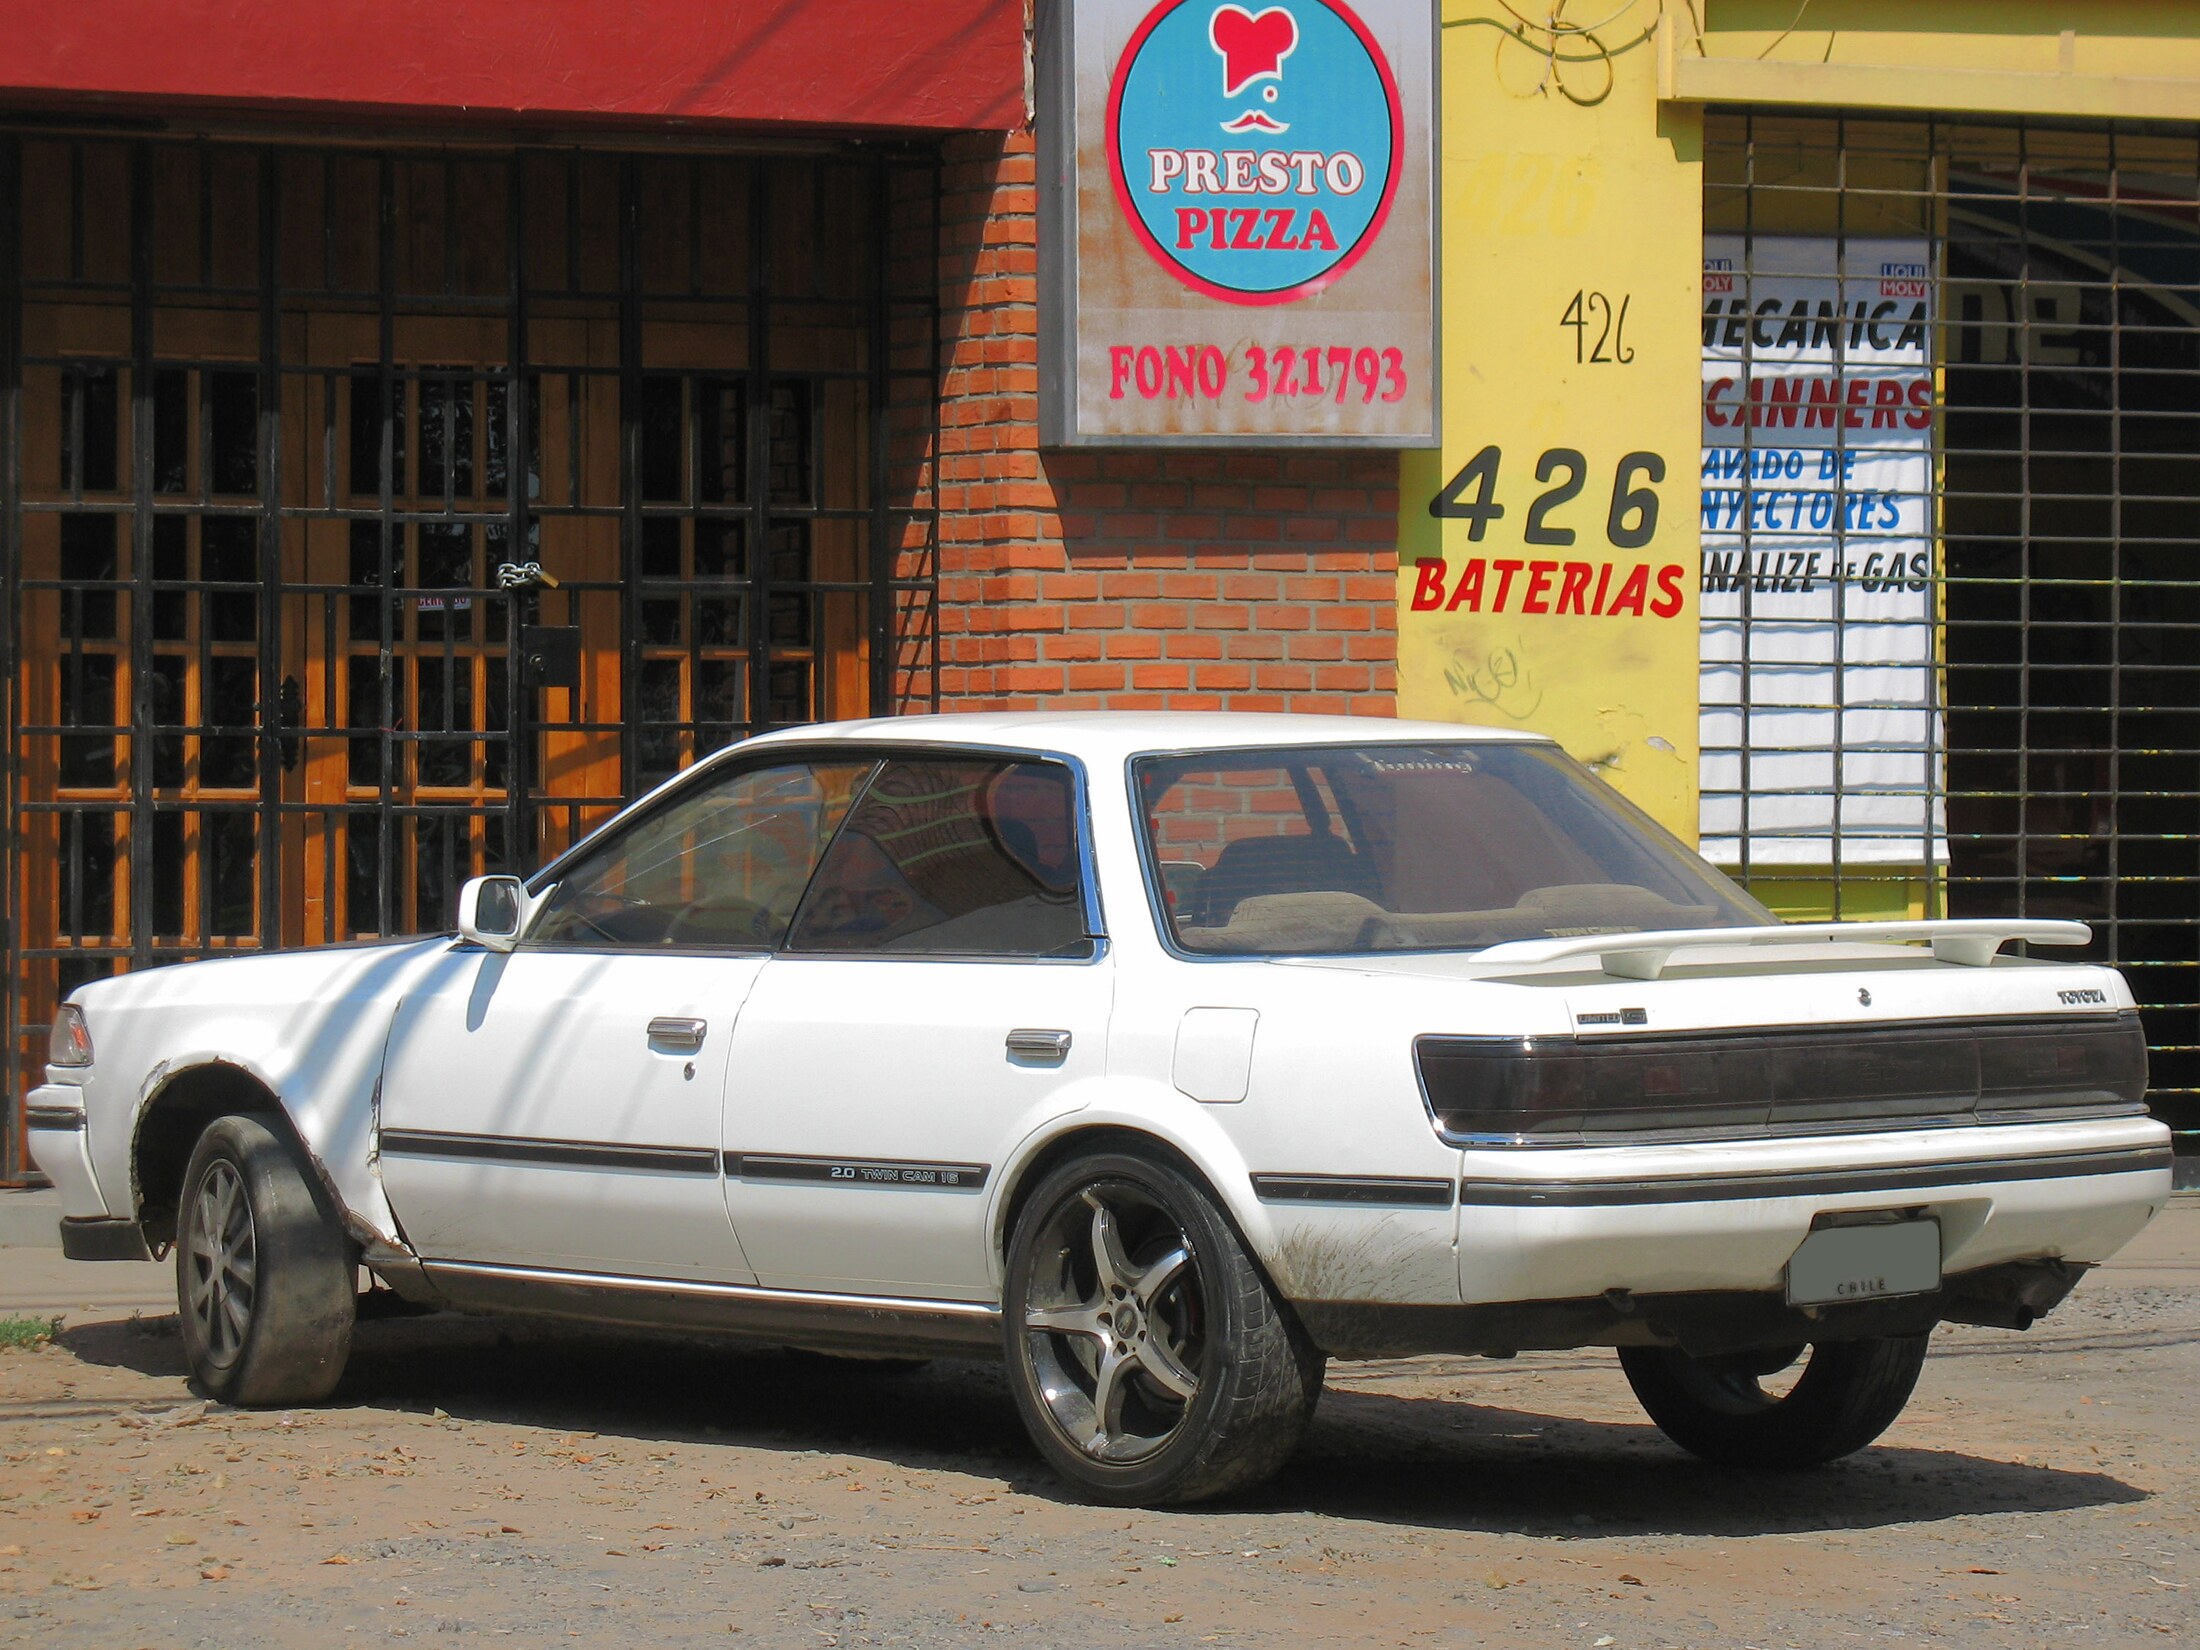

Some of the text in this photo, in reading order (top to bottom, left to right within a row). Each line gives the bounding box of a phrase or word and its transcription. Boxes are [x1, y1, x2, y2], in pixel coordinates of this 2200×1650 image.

[1147, 148, 1365, 195] PRESTO
[1174, 207, 1340, 252] PIZZA
[1881, 280, 1925, 295] MOLY
[1559, 289, 1635, 365] 426
[1109, 344, 1408, 405] FONO 321793
[1702, 377, 1933, 430] CANNERS
[1818, 450, 1857, 480] DE
[1429, 444, 1667, 549] 426
[1410, 557, 1685, 619] BATERIAS
[1701, 552, 1822, 593] NALIZE
[1861, 552, 1929, 593] GAS
[2057, 989, 2107, 1005] TOYOTA
[831, 1167, 959, 1184] 2.0 TWIN CAM 16
[1837, 1278, 1886, 1295] CHILE
